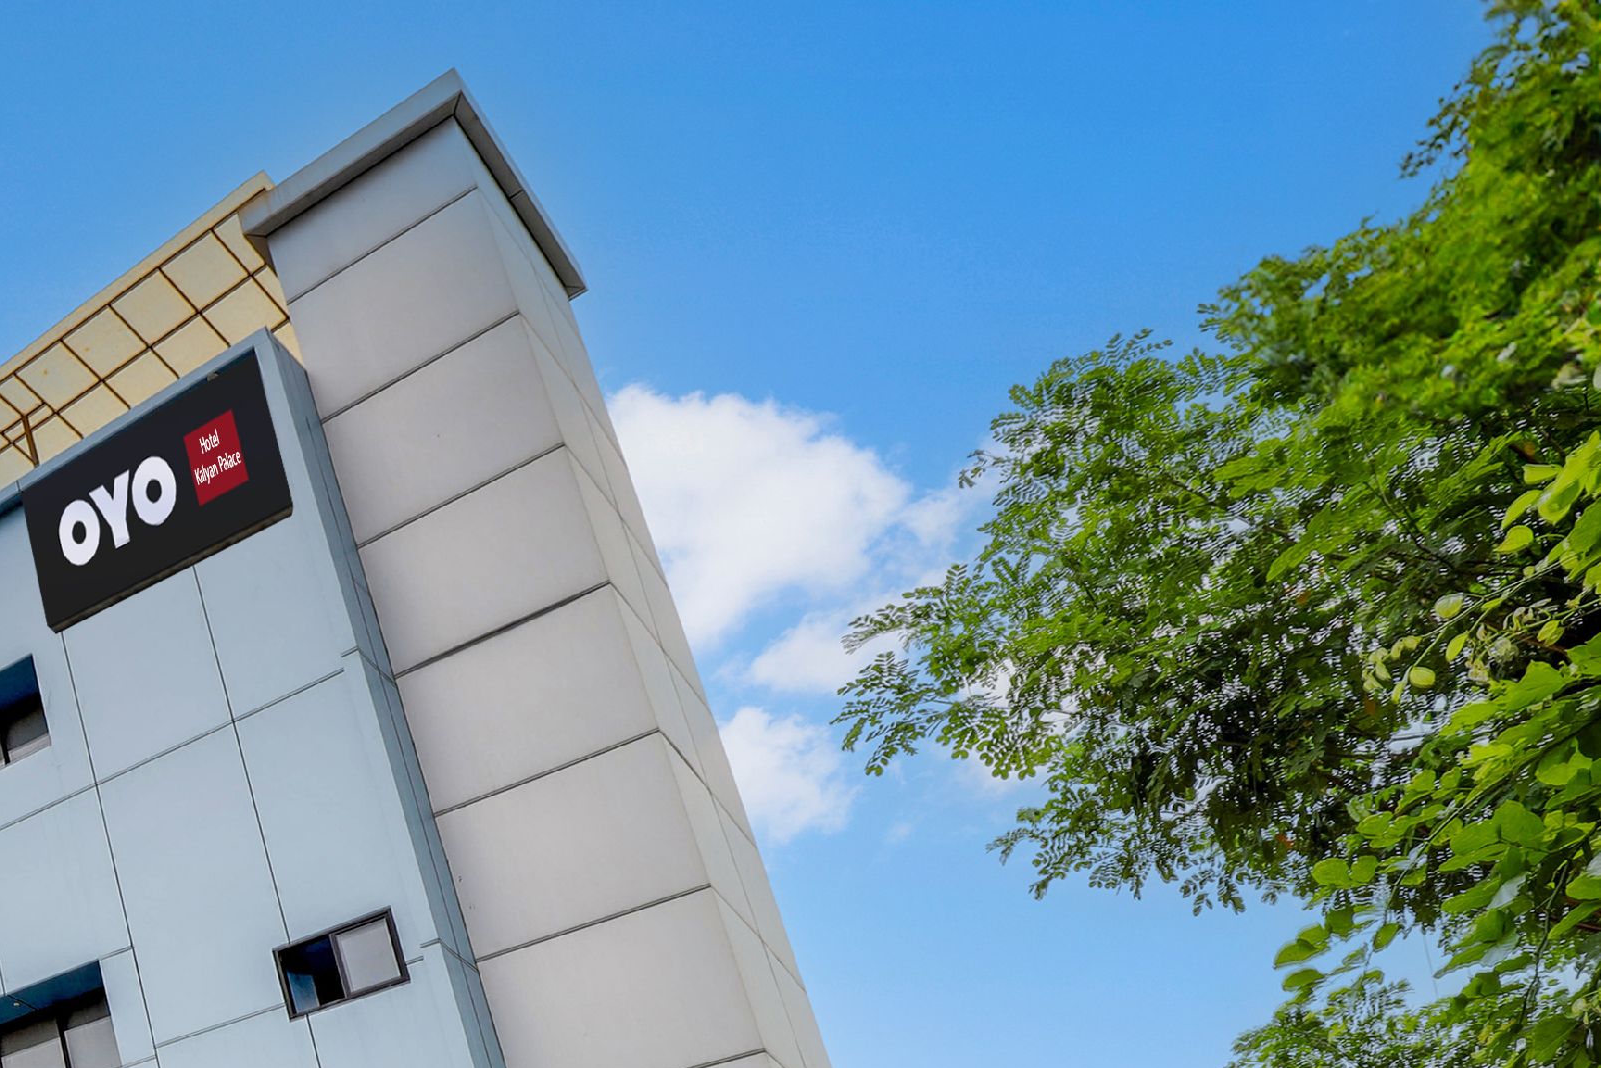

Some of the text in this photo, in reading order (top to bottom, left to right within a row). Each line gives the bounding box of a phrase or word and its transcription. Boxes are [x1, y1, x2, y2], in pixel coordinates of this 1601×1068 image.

[199, 429, 220, 454] Hotel
[194, 451, 242, 485] Kalyan Palace
[59, 455, 177, 566] OYO
